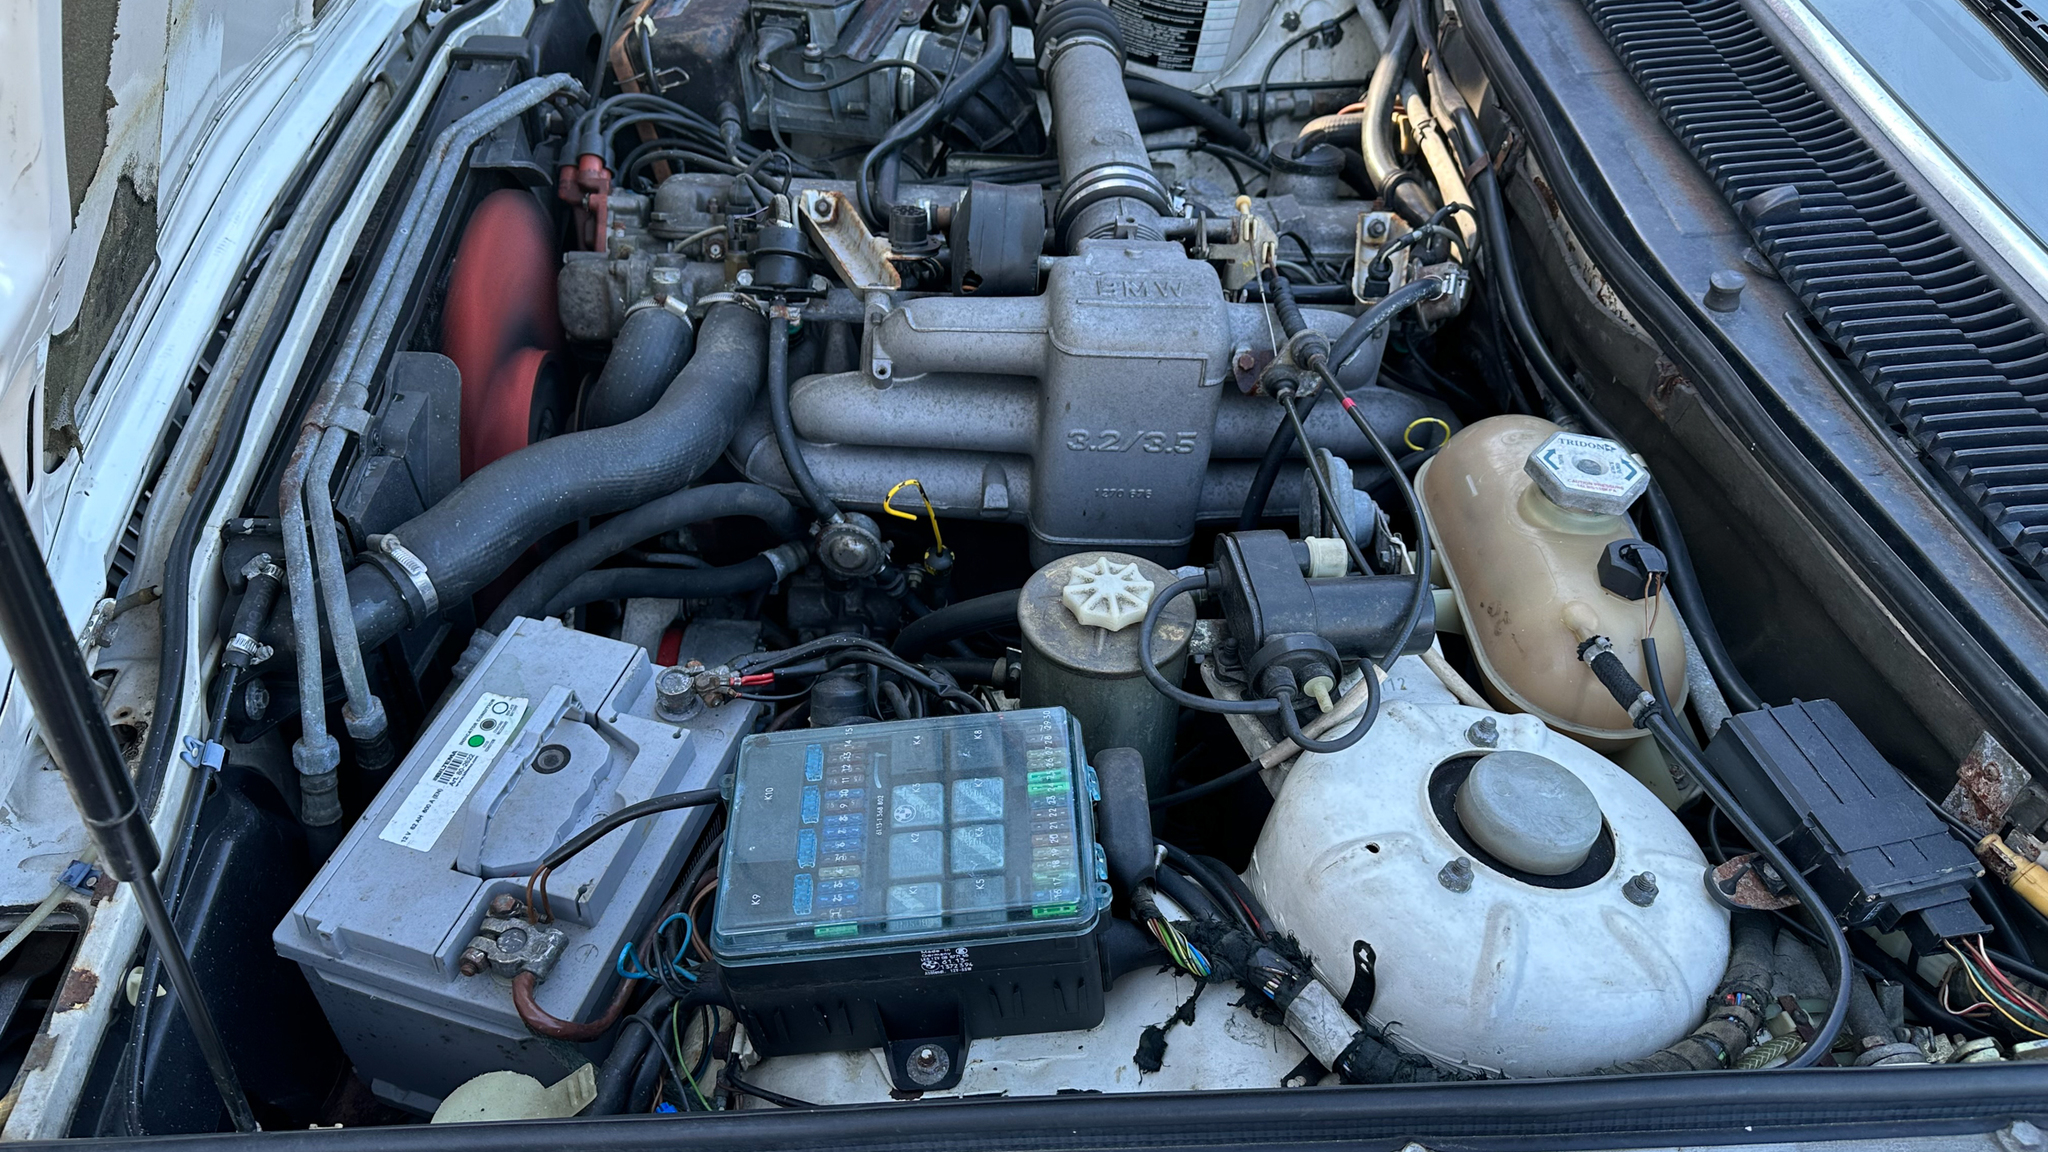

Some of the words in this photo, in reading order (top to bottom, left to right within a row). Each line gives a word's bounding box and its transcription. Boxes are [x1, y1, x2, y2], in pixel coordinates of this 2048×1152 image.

[1095, 277, 1185, 299] BMW
[1066, 428, 1198, 454] 3.2/3.5
[1558, 438, 1605, 450] TRIDON
[1043, 710, 1051, 719] 30
[1043, 720, 1052, 730] 29
[845, 727, 853, 735] 15
[974, 729, 982, 739] K8
[913, 735, 921, 745] K4
[1044, 735, 1052, 744] 28
[1045, 746, 1053, 754] 27
[1045, 757, 1054, 767] 26
[1046, 770, 1055, 780] 25
[974, 777, 983, 787] K7
[1047, 783, 1055, 791] 24
[912, 783, 921, 792] K3
[764, 787, 774, 801] K10
[1049, 808, 1057, 817] 22
[1049, 821, 1058, 829] 21
[975, 826, 984, 837] K6
[911, 832, 919, 843] K2
[1050, 833, 1058, 843] 20
[1052, 860, 1060, 868] 18
[976, 878, 985, 890] K5
[1053, 877, 1061, 885] 17
[909, 885, 918, 894] K1
[751, 894, 761, 905] K9
